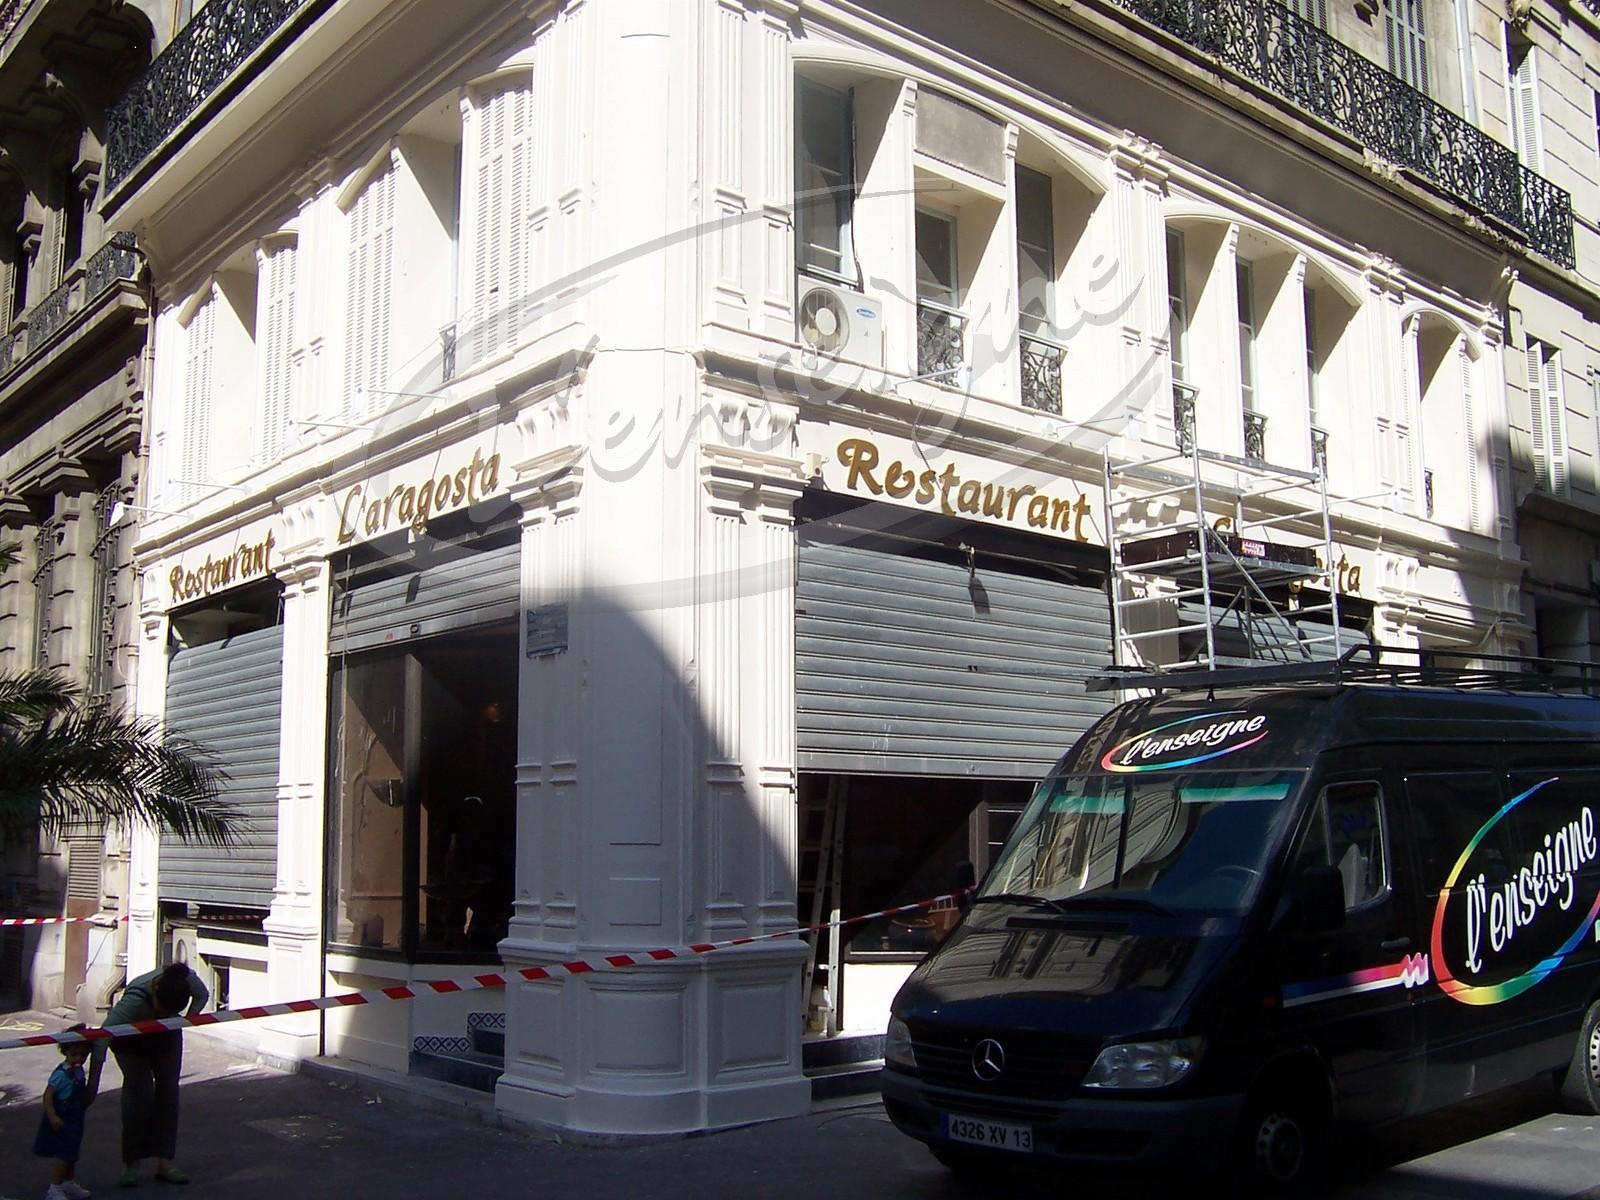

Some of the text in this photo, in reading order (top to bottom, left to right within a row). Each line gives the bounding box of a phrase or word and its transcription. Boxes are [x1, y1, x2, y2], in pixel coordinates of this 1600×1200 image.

[336, 447, 501, 545] L'aragosta
[837, 438, 1091, 544] Restaurant
[169, 528, 276, 603] Restaurant
[1119, 715, 1267, 765] l'enseigne
[1465, 806, 1597, 974] l'enseigne
[951, 1119, 1032, 1148] 4326 XV 13
